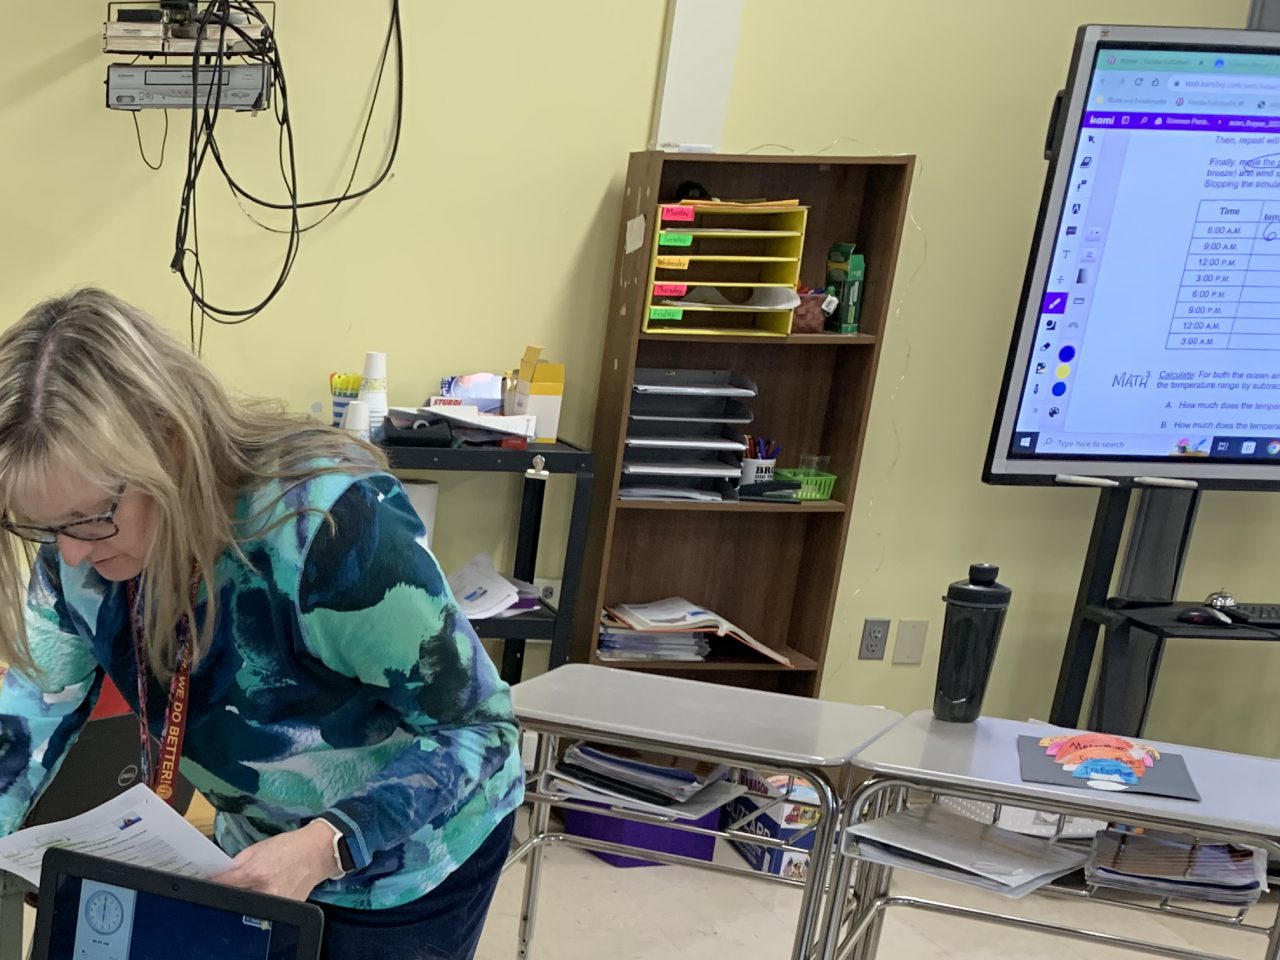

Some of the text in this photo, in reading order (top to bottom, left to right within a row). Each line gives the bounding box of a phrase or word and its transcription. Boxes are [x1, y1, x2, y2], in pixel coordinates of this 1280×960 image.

[1089, 115, 1115, 125] kami
[1204, 179, 1239, 189] Stopping
[1241, 180, 1253, 188] the
[665, 206, 689, 218] Monday
[1220, 206, 1240, 215] Time
[1213, 371, 1230, 379] both
[1112, 372, 1147, 388] MATH
[1170, 382, 1216, 390] temperature
[1218, 383, 1240, 391] range
[1241, 382, 1250, 391] by
[1179, 401, 1196, 409] How
[1174, 421, 1191, 429] How
[1193, 421, 1213, 429] much
[1215, 422, 1234, 430] does
[1236, 422, 1248, 430] the
[1058, 440, 1074, 448] Type
[1102, 440, 1124, 448] search
[175, 676, 186, 699] WE
[171, 701, 183, 723] DO
